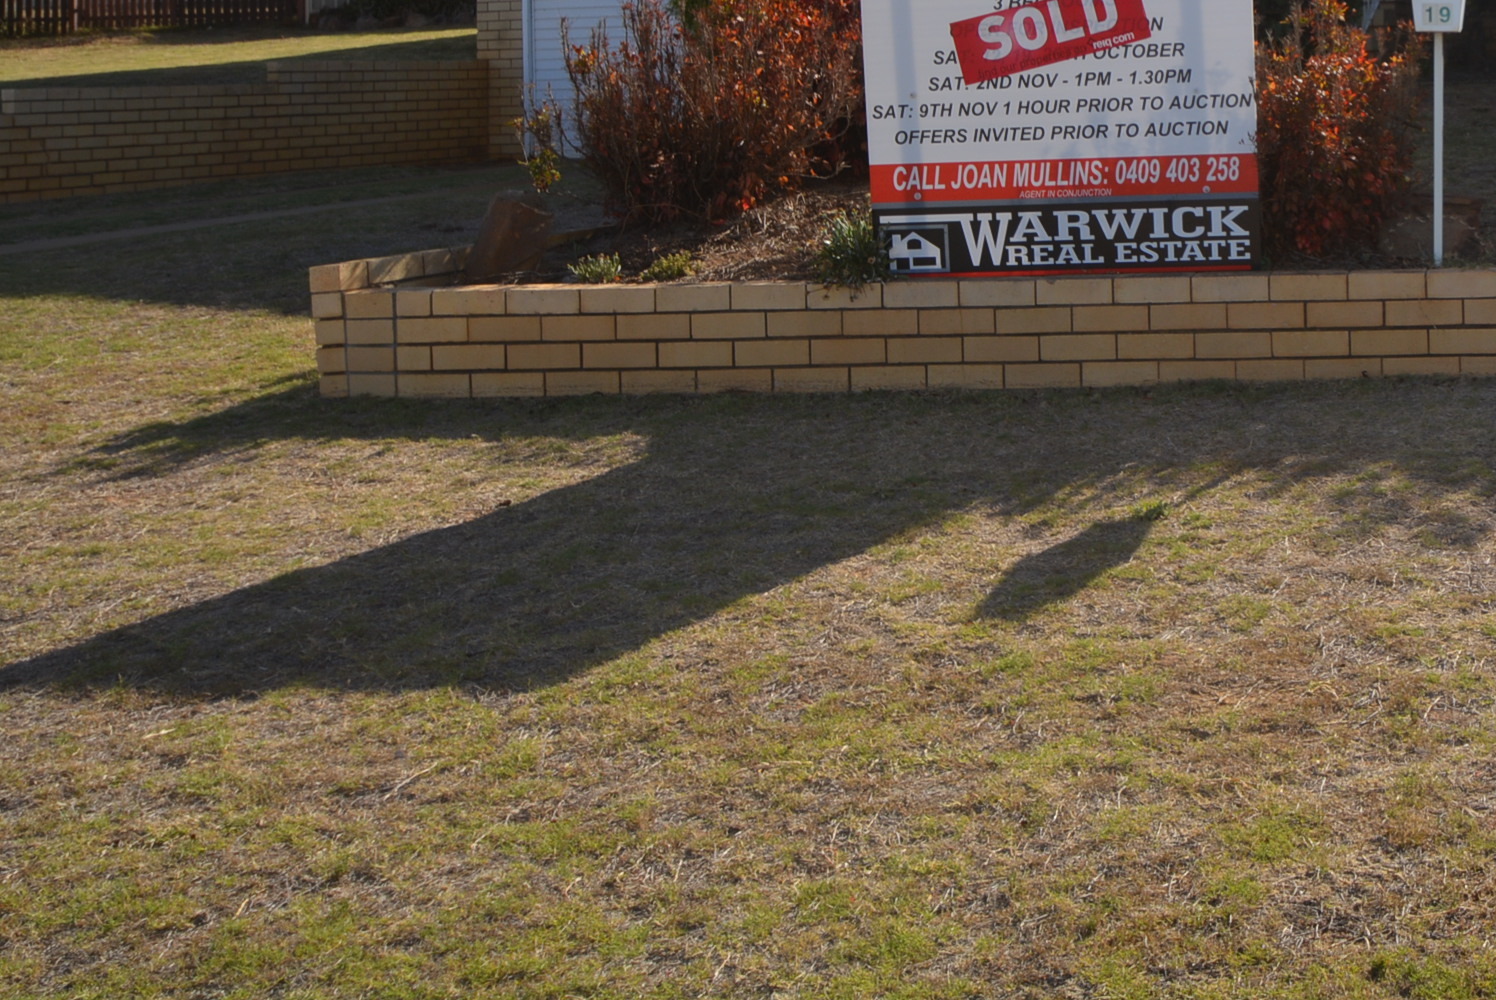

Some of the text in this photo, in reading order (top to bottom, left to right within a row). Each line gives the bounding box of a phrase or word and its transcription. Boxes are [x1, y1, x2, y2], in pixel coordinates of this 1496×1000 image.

[1425, 6, 1451, 23] 19
[1093, 43, 1185, 59] OCTOBER
[977, 75, 1012, 90] 2ND
[1018, 73, 1058, 88] NOV
[1075, 71, 1112, 86] 1PM
[1129, 69, 1192, 85] 1.30PM
[872, 93, 1252, 119] SAT: 9TH NOV 1 HOUR PRIOR TO AUCTION
[894, 120, 1229, 145] OFFERS INVITED PRIOR TO AUCTION
[893, 156, 1240, 191] CALL JOAN MULLINS: 0409 403 258
[1019, 188, 1112, 199] AGENT IN CONJUNCTION
[956, 205, 1250, 267] WARWICK
[1006, 240, 1251, 266] REAL ESTATE
